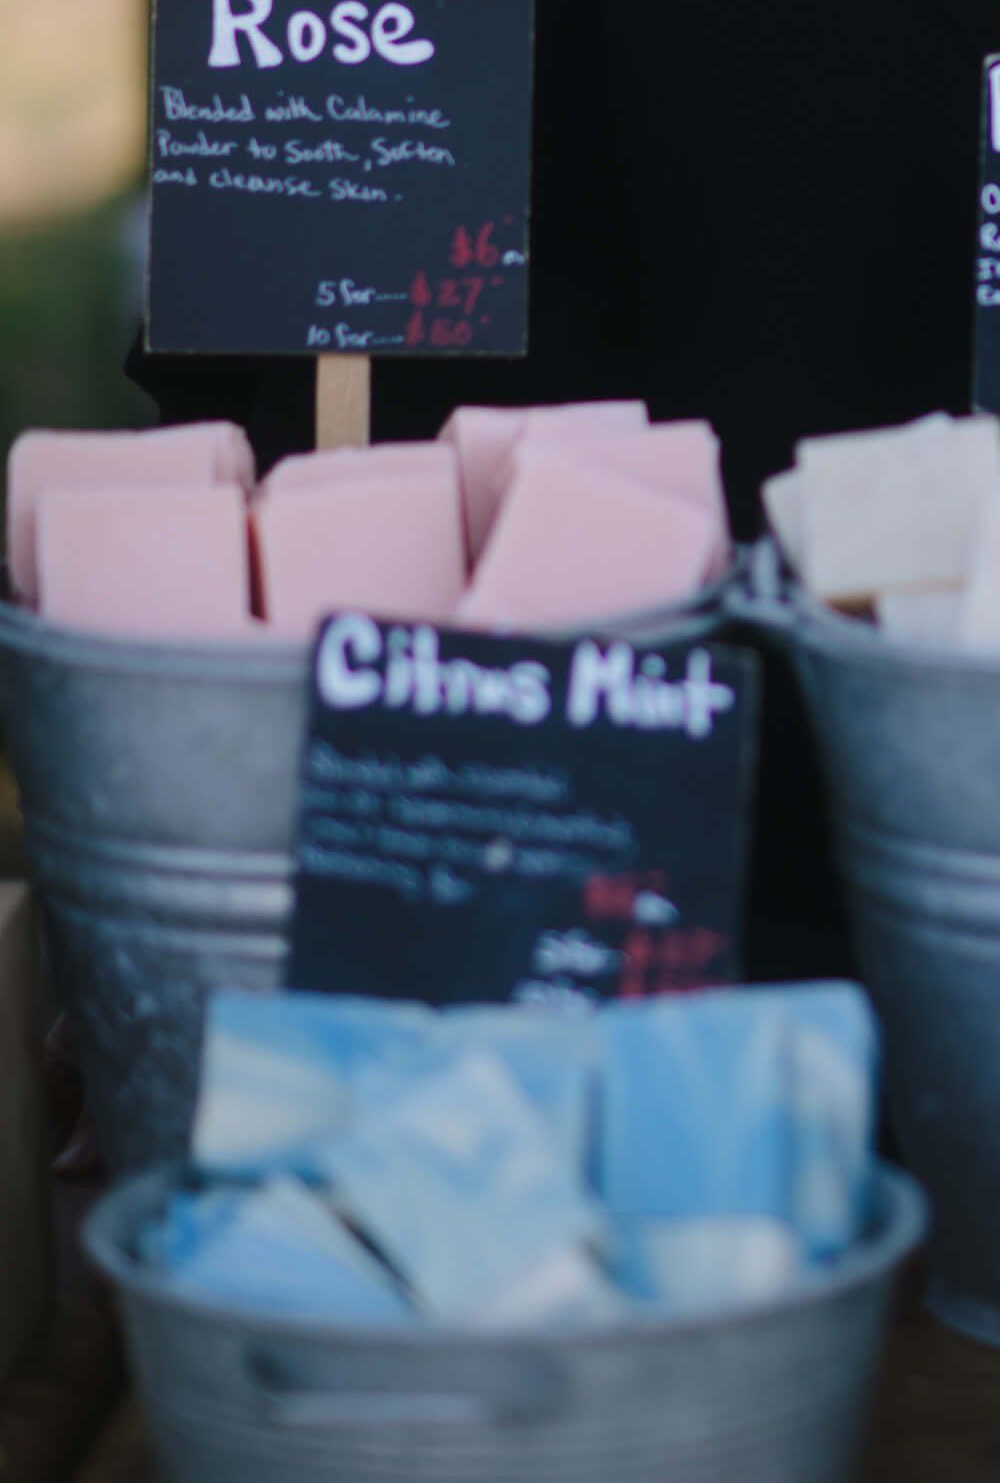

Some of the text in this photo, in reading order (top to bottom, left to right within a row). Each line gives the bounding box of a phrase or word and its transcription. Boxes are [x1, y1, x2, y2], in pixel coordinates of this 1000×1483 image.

[159, 85, 451, 128] Blended with Calamine
[157, 128, 238, 159] Powder
[248, 137, 277, 161] to
[154, 168, 198, 187] and
[210, 168, 323, 198] cleanse
[316, 613, 735, 739] Citrus Mint
